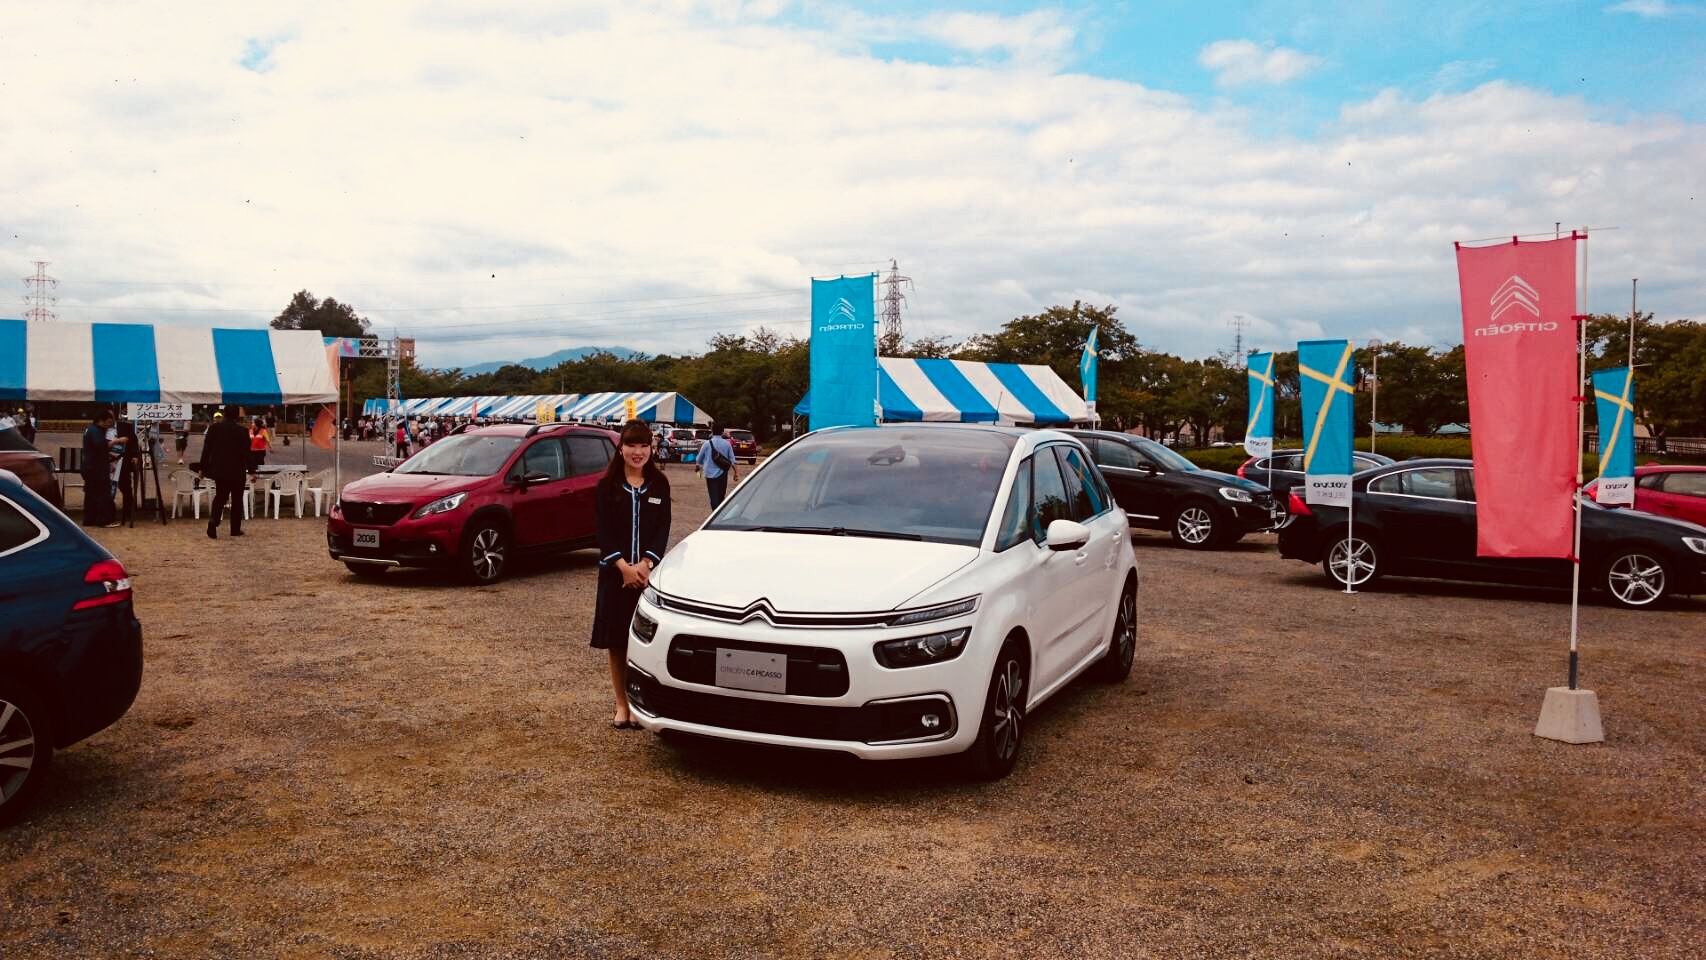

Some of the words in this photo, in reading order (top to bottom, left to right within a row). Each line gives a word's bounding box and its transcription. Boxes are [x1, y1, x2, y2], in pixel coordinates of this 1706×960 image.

[136, 411, 183, 419] シトロエン大分
[356, 534, 376, 544] 2008
